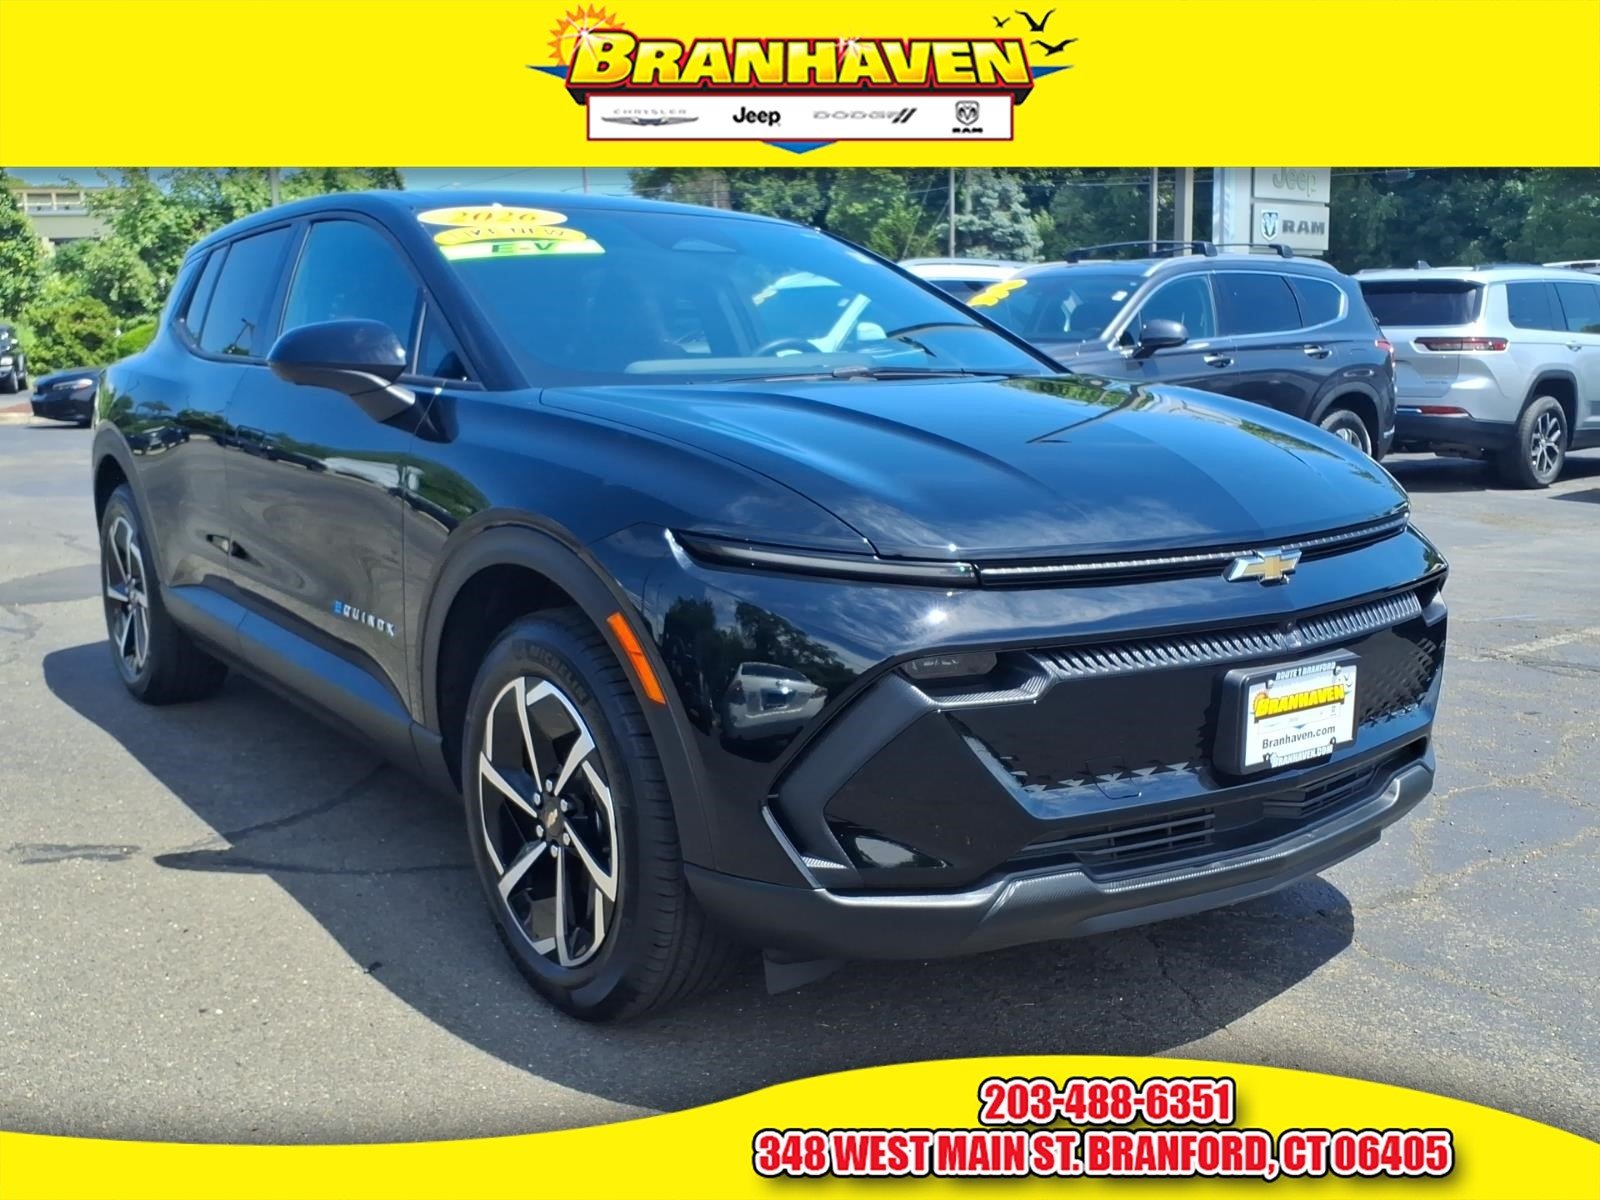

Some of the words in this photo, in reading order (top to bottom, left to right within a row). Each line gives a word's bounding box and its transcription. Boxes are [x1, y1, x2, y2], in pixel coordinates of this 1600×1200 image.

[1272, 167, 1317, 197] Jeep
[1282, 219, 1326, 235] RAM
[333, 600, 396, 637] EQUINOX
[1255, 685, 1345, 717] BRANHAVEN
[1262, 725, 1336, 750] Branhaven.com
